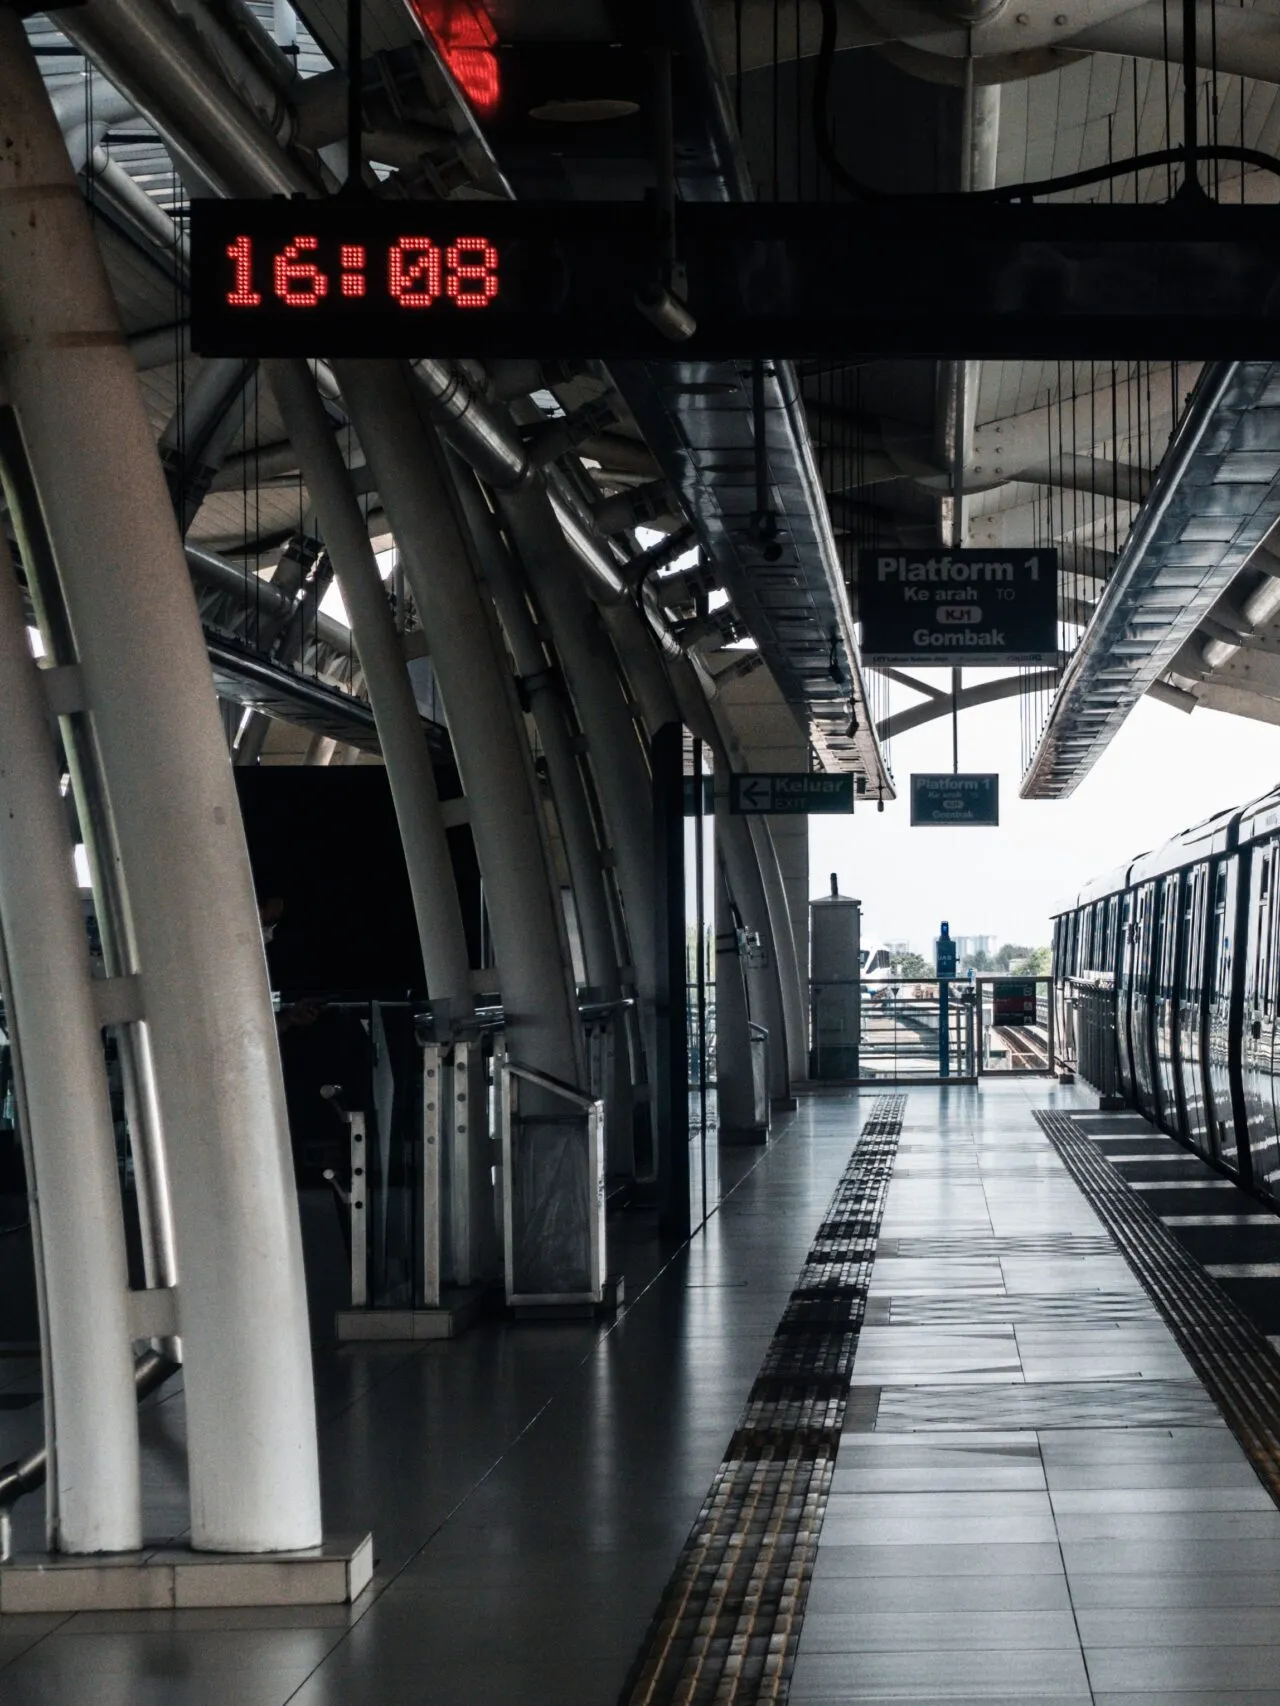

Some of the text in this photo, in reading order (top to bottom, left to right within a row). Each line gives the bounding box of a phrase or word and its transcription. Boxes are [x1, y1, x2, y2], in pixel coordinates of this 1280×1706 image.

[225, 235, 499, 308] 16:08
[877, 556, 1040, 581] Platform 1
[904, 586, 1016, 601] Ke arah TO
[945, 609, 972, 621] KJ1
[912, 628, 1006, 646] Gombak
[775, 778, 845, 793] Keluar
[916, 778, 990, 790] Platform 1
[775, 797, 807, 809] EXIT
